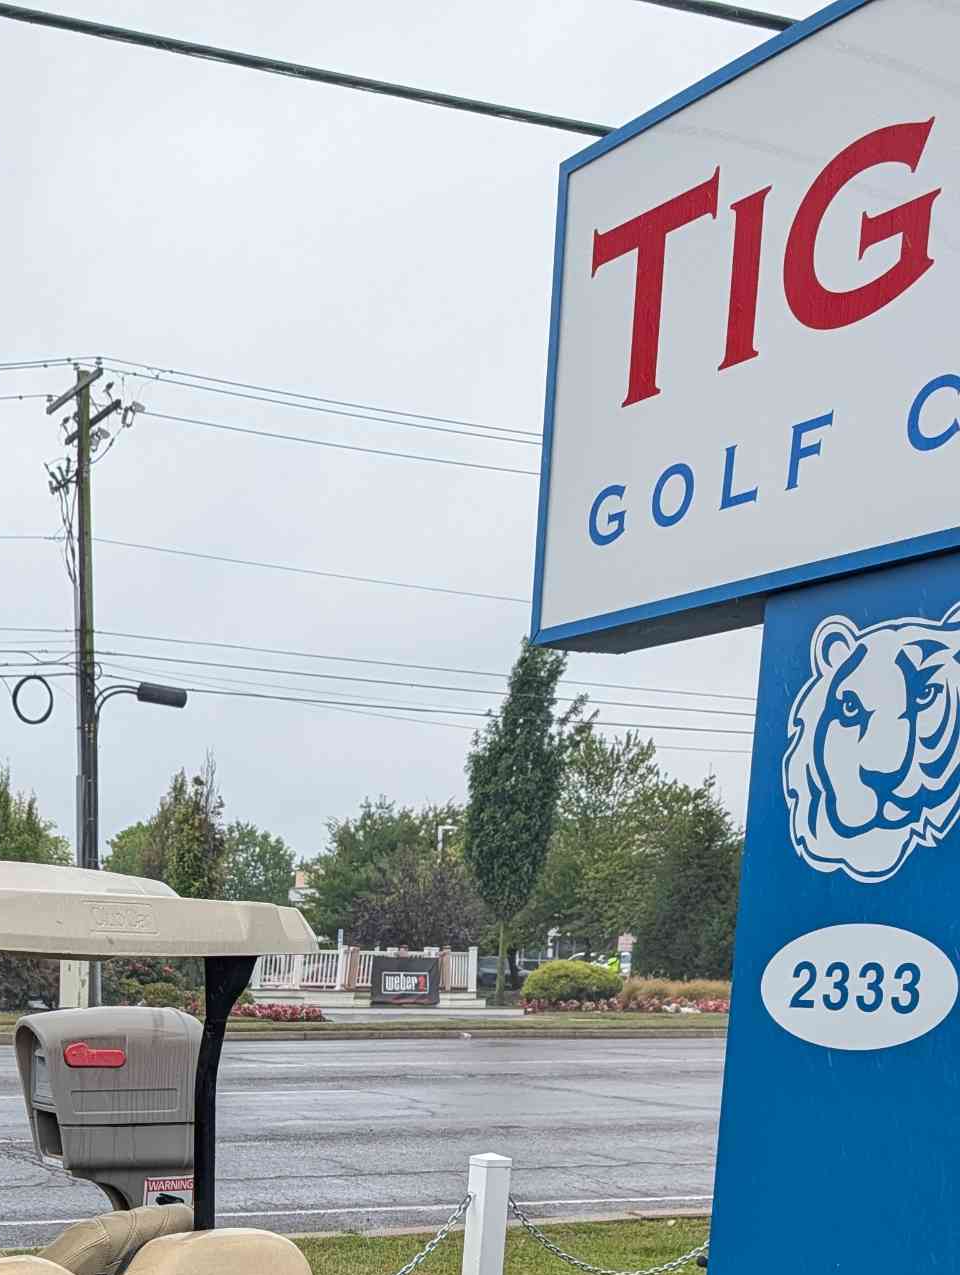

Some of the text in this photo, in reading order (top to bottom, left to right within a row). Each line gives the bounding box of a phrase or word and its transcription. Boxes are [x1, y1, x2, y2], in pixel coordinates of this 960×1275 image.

[591, 115, 942, 409] TIG
[588, 409, 835, 547] GOLF
[385, 973, 418, 991] weber
[789, 960, 922, 1015] 2333
[148, 1179, 194, 1191] WARNING
